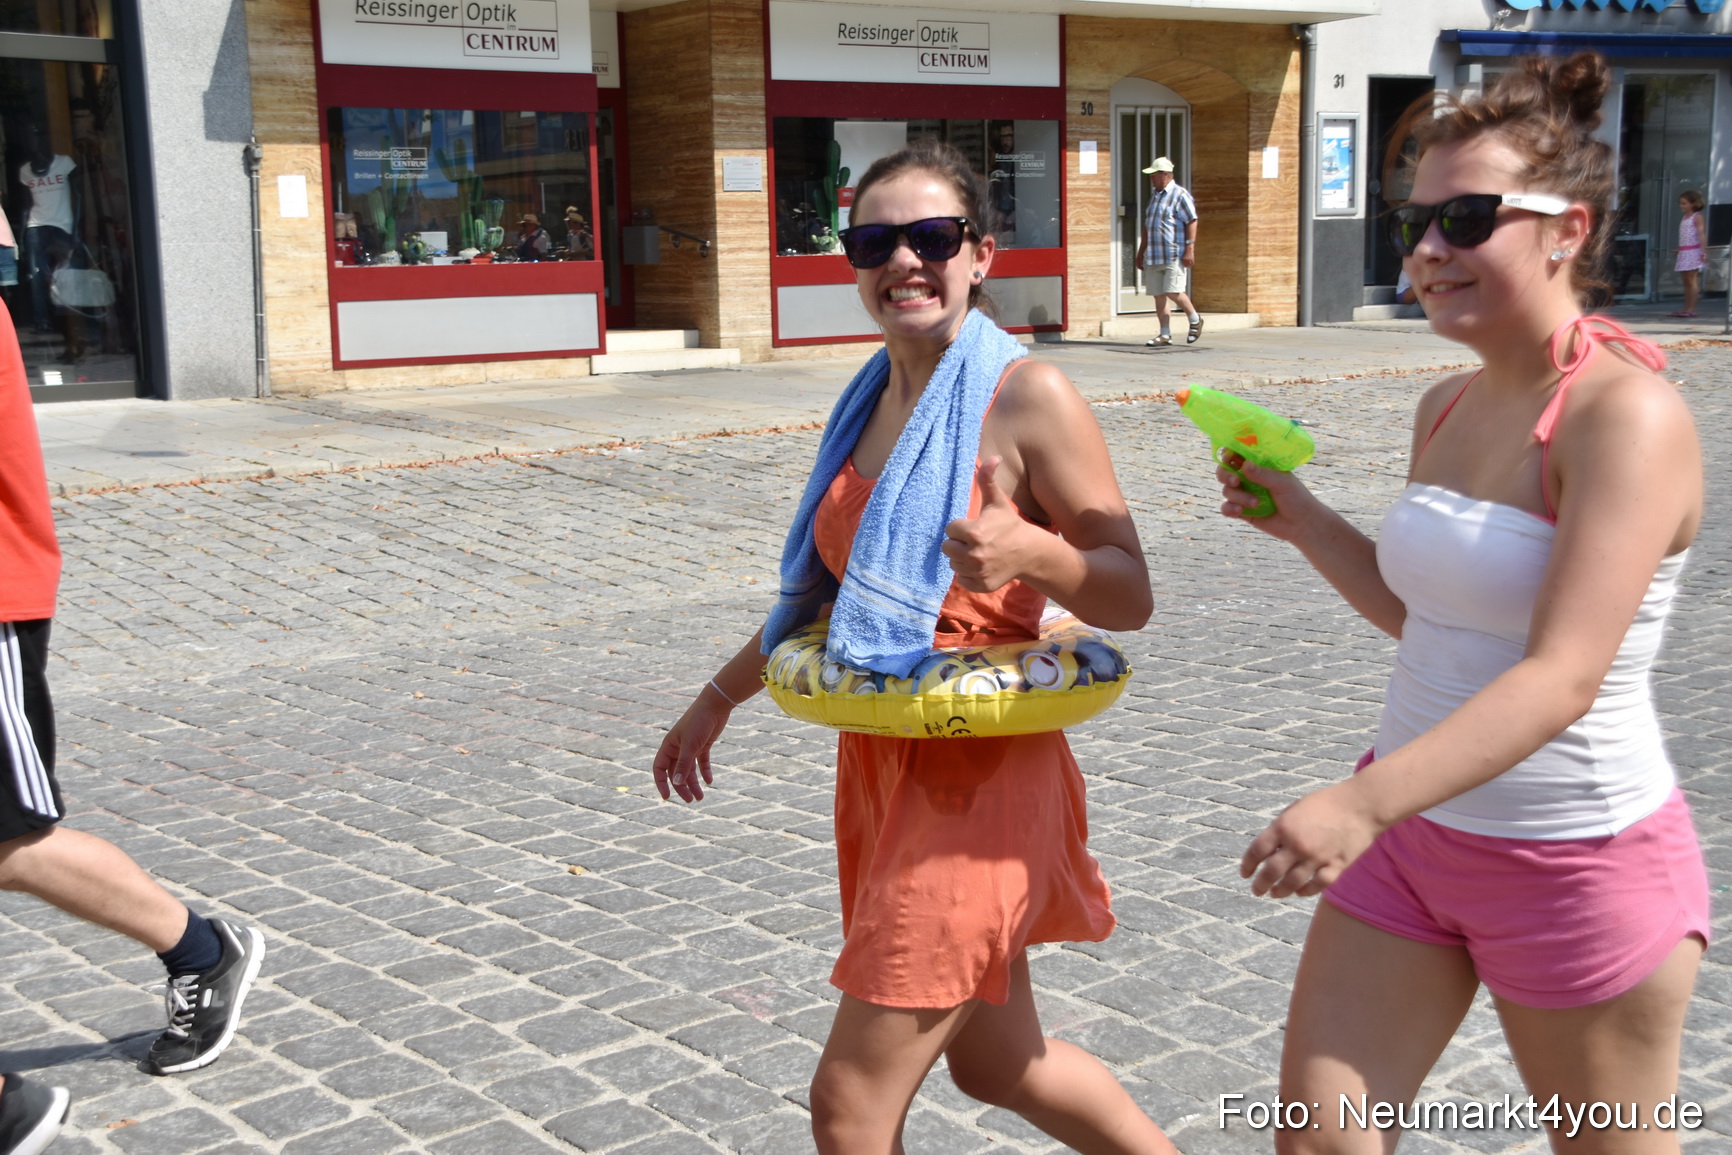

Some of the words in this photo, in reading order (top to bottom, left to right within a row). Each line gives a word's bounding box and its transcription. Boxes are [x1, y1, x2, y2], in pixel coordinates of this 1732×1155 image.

[355, 0, 458, 23] Reissinger
[466, 2, 517, 25] Optik
[837, 22, 915, 45] Reissinger
[920, 26, 959, 46] Optik
[466, 33, 556, 52] CENTRUM
[920, 52, 988, 68] CENTRUM
[1333, 74, 1345, 89] 31
[1080, 101, 1094, 116] 30
[353, 149, 390, 158] Reissinger
[392, 149, 412, 159] Optik
[392, 160, 427, 168] CENTRUM
[28, 174, 65, 189] SALE
